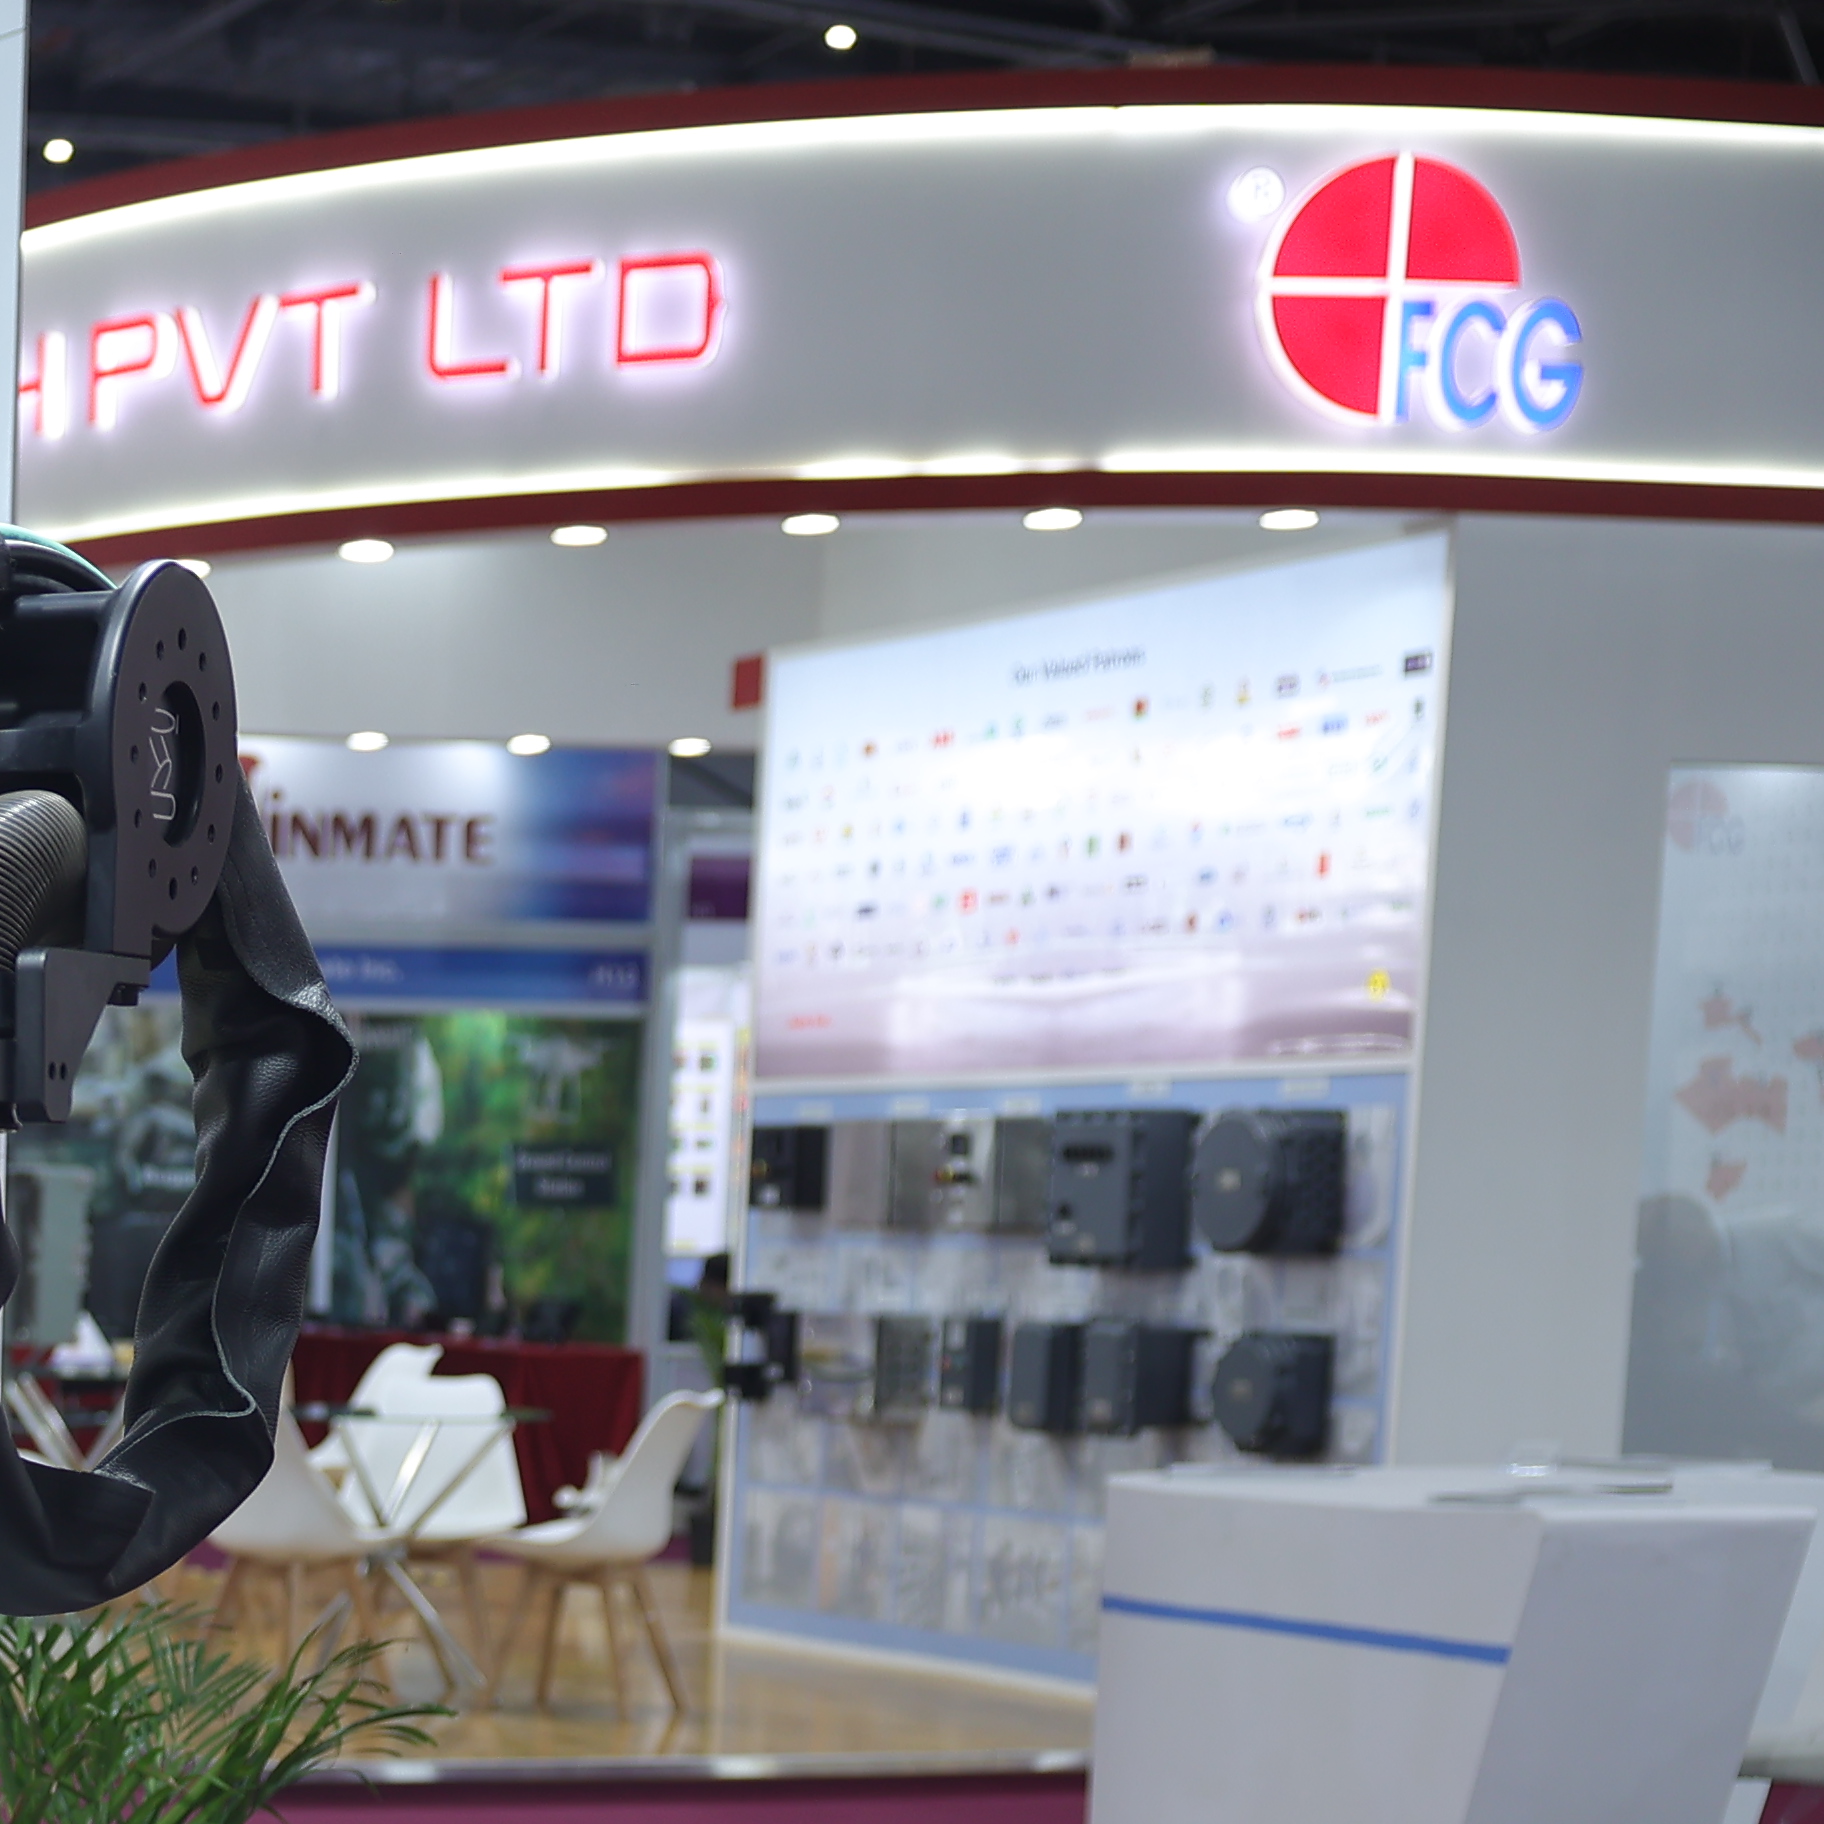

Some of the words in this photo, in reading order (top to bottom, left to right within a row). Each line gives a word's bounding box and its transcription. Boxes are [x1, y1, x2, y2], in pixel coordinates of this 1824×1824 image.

[88, 282, 364, 428] PVT
[426, 252, 725, 379] LTD
[1396, 297, 1584, 435] FCG
[240, 757, 494, 864] iNMATE
